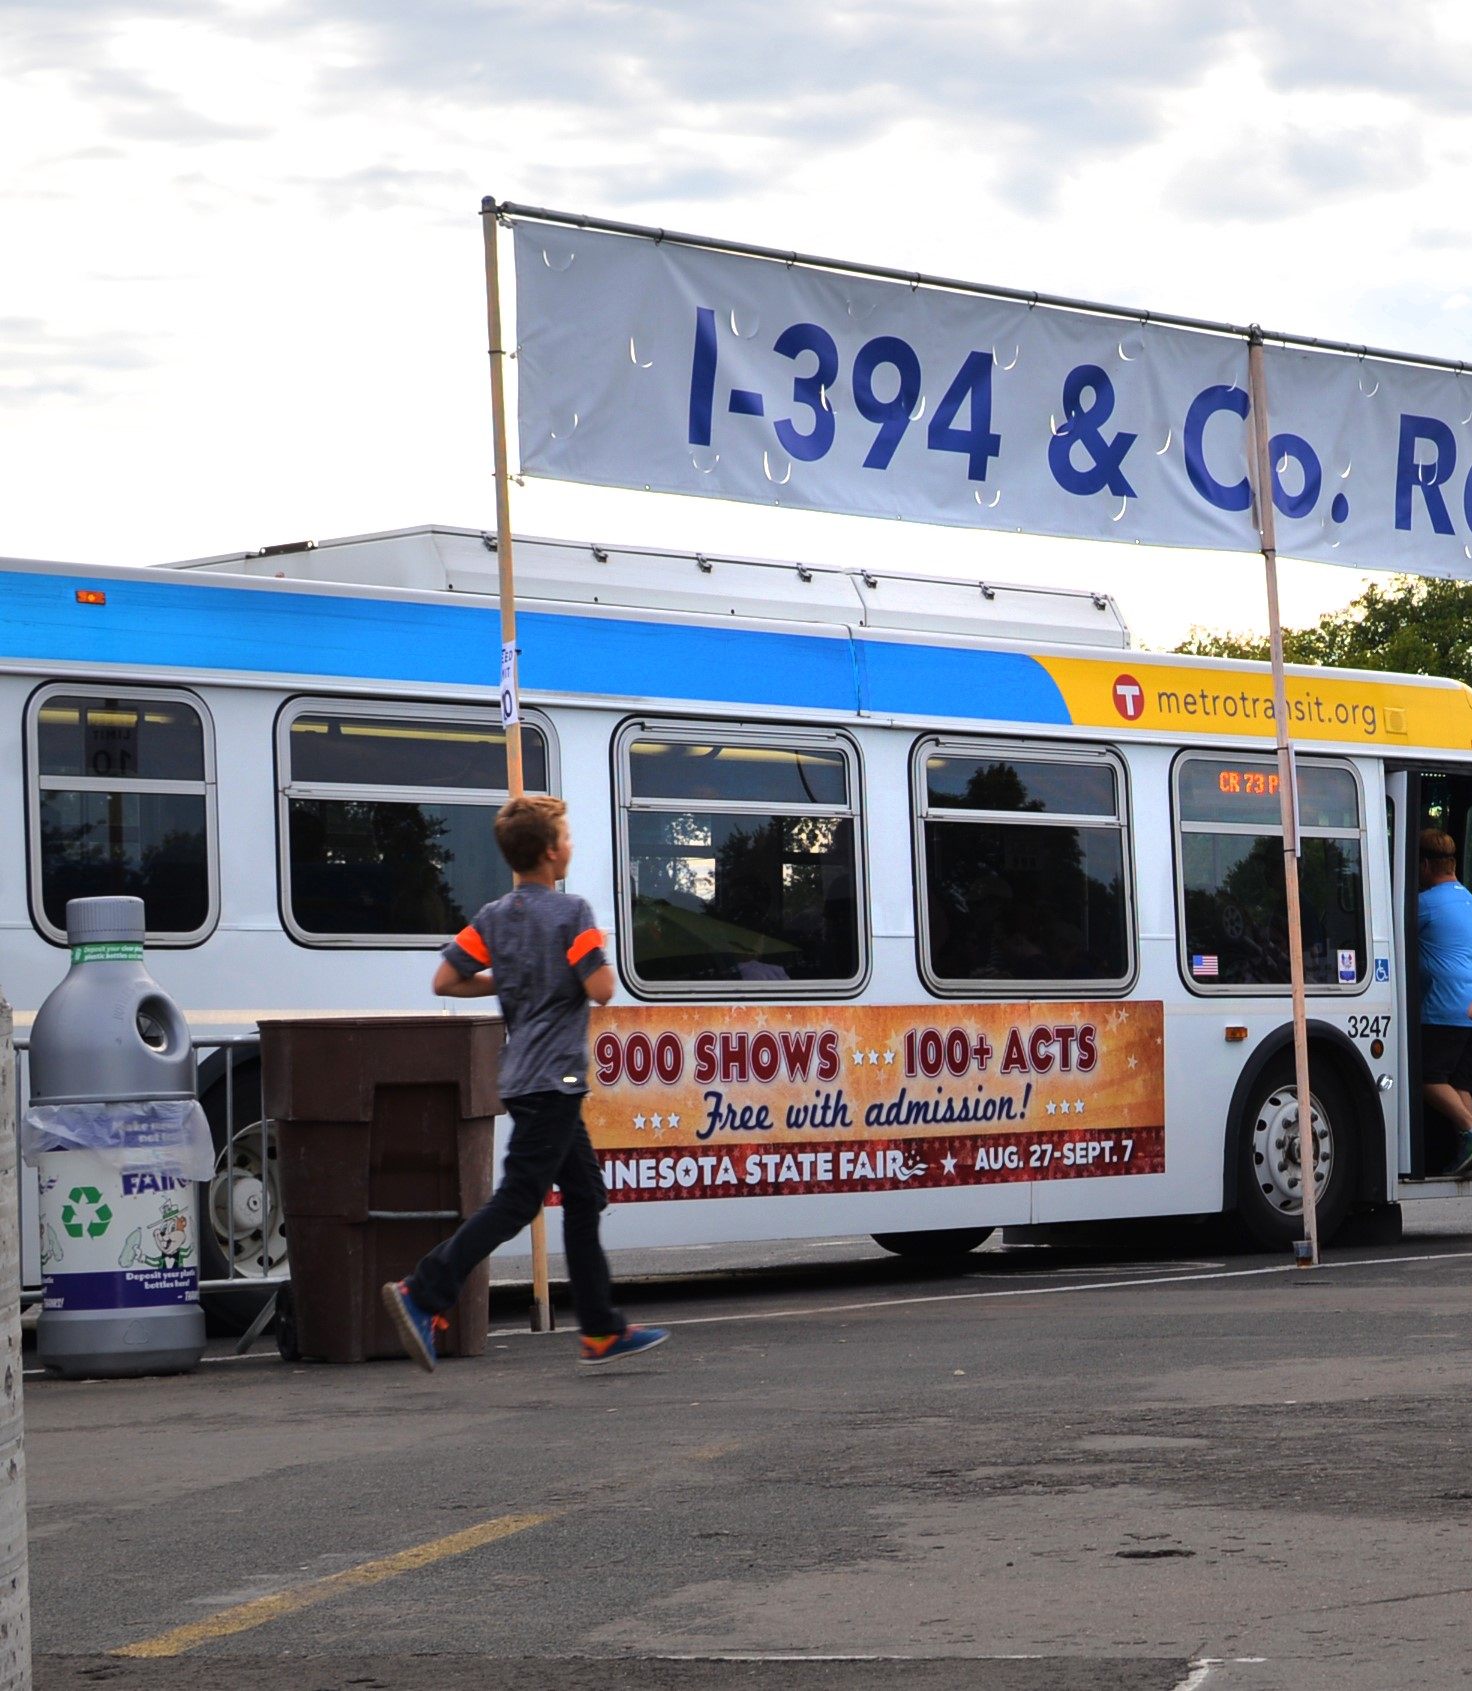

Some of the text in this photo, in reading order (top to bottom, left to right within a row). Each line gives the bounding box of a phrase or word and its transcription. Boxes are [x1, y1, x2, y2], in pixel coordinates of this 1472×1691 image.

[688, 307, 1001, 482] I-394
[1047, 364, 1138, 499] &
[1184, 384, 1349, 524] Co.
[1157, 689, 1377, 735] metrotransit.org
[1219, 771, 1240, 793] CR
[1243, 773, 1265, 794] 73
[1348, 1015, 1391, 1039] 3247
[595, 1023, 1098, 1086] 900 SHOWS 100+ ACTS
[696, 1083, 1032, 1140] Free with admission!
[600, 1140, 1134, 1190] NNESOTA STATE FAIR AUG. 27-SEPT. 7
[125, 1271, 161, 1282] Deposit
[145, 1281, 174, 1290] bottles
